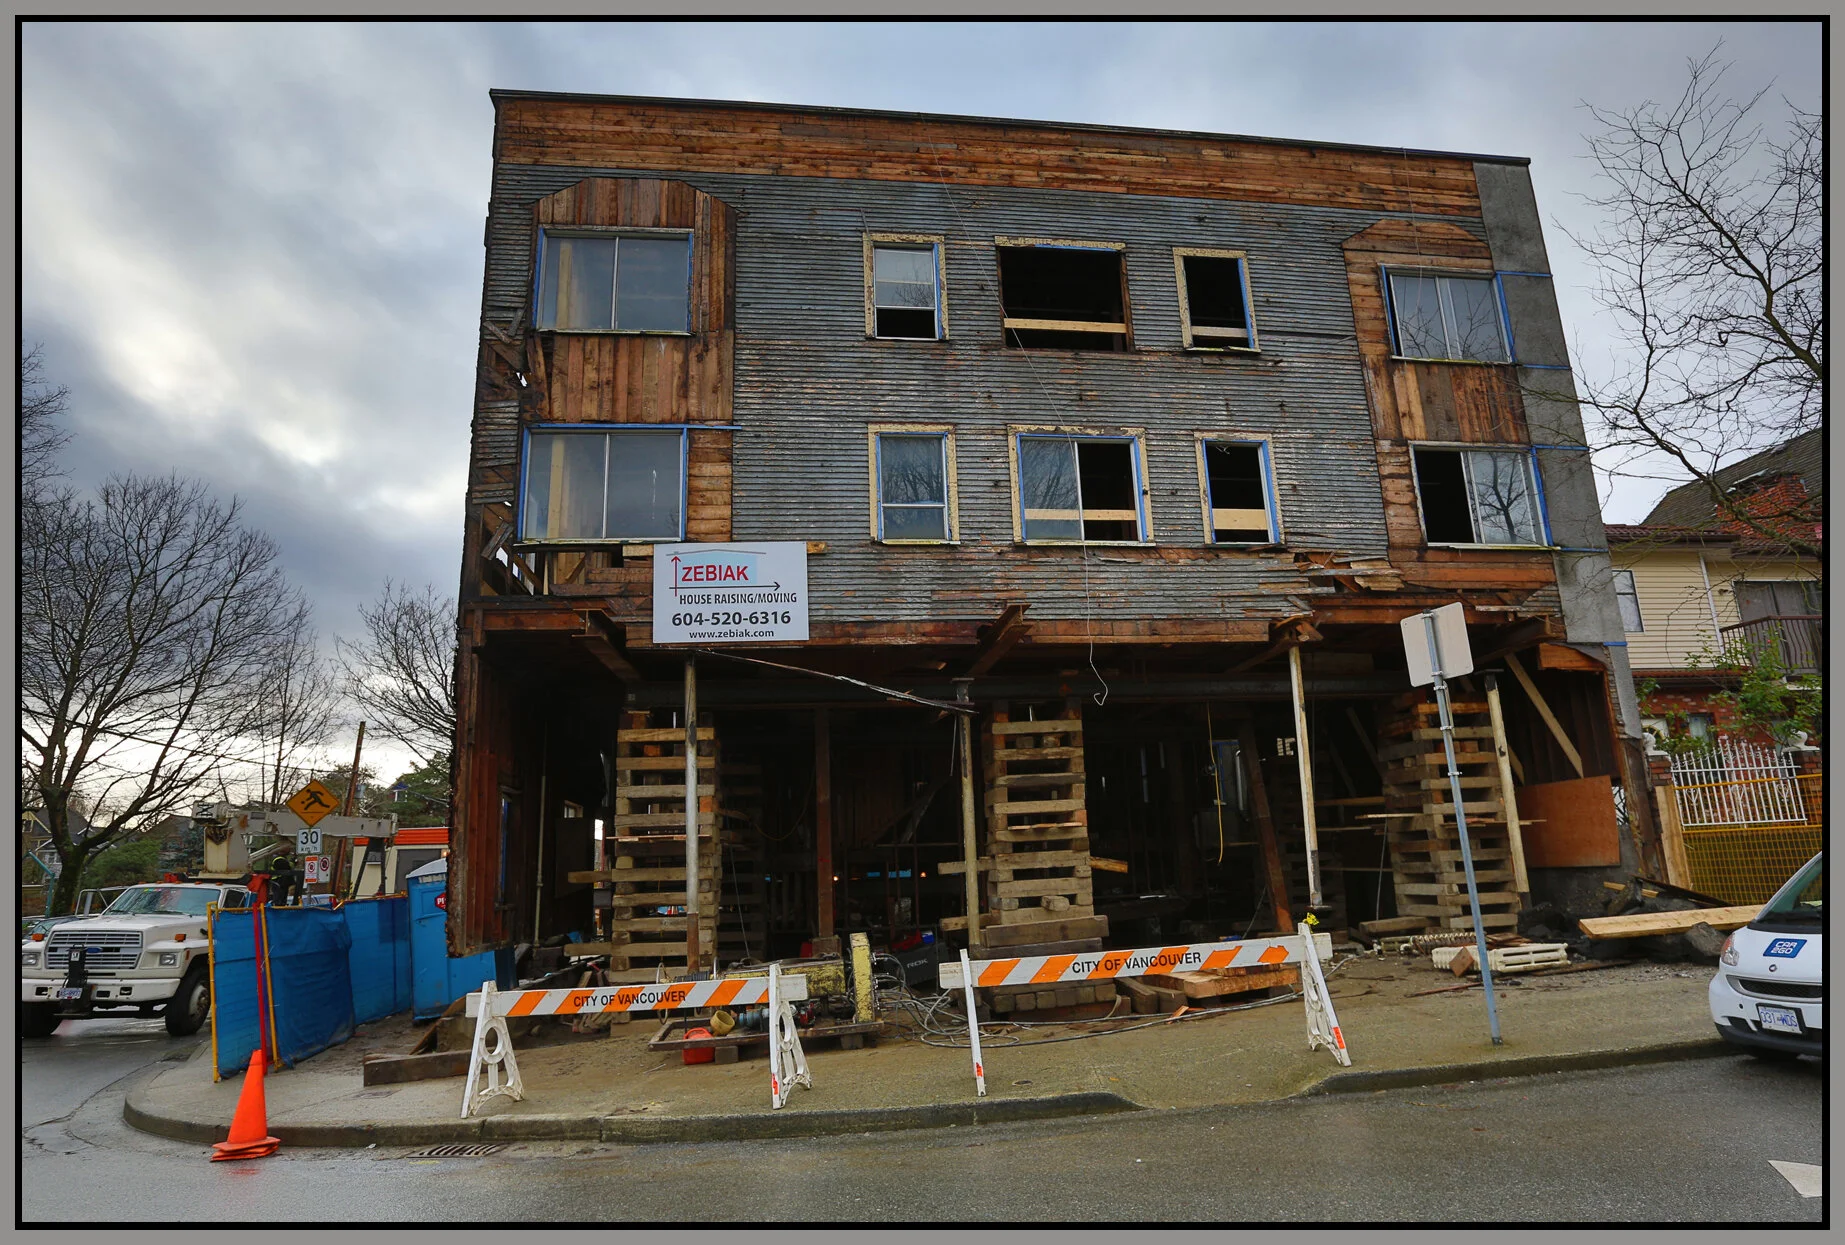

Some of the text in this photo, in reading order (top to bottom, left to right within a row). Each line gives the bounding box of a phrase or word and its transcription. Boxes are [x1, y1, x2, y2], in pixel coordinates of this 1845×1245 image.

[681, 565, 749, 582] ZEBIAK
[679, 592, 797, 605] HOUSE RAISING/MOVING
[671, 610, 791, 627] 604-520-6316
[689, 629, 774, 639] www.zebiak.com
[300, 831, 319, 845] 30
[1072, 952, 1202, 973] CITY OF VANCOUVER
[573, 991, 686, 1007] CITY OF VANCOUVER
